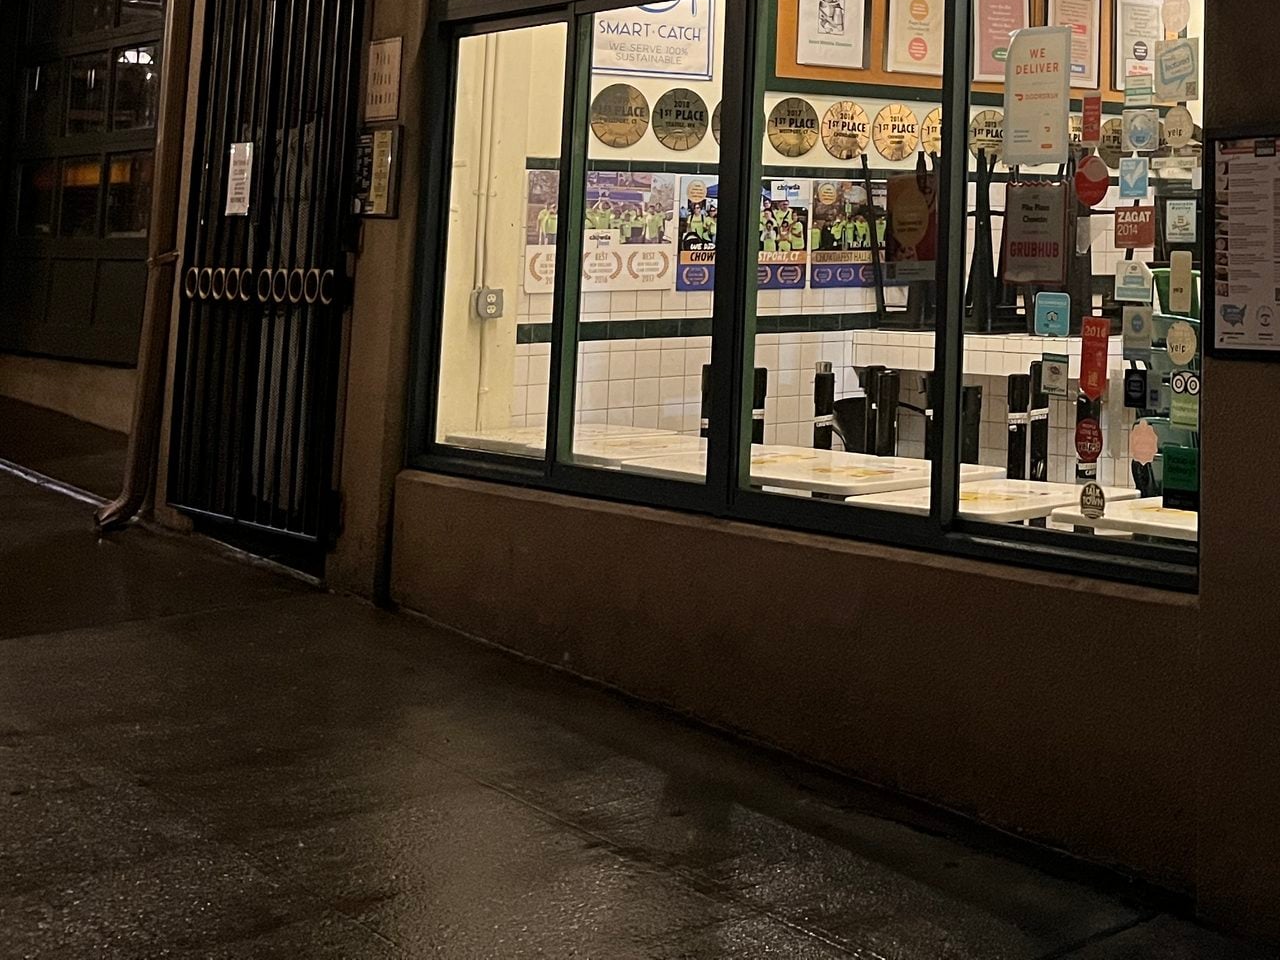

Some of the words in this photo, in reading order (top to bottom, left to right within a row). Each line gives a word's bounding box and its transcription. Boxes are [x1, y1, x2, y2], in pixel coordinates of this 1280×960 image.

[599, 20, 651, 37] SMART
[658, 25, 701, 41] CATCH
[609, 42, 628, 51] WE
[630, 44, 662, 54] SERVE
[666, 46, 688, 56] 100%
[1029, 48, 1046, 58] WE
[616, 53, 682, 65] SUSTAINABLE
[1016, 62, 1059, 74] DELIVER
[659, 109, 672, 119] 1ST
[675, 110, 704, 121] PLACE
[774, 118, 786, 127] 1ST
[789, 118, 815, 129] PLACE
[828, 120, 840, 130] 1ST
[841, 121, 866, 133] PLACE
[878, 124, 889, 133] 1ST
[891, 124, 915, 134] PLACE
[974, 128, 984, 137] 1ST
[986, 129, 1003, 138] PLAC
[1168, 128, 1183, 137] yelp
[1117, 211, 1151, 222] ZAGAT
[1117, 224, 1138, 235] 2014
[1010, 241, 1059, 257] GRUBHUB
[690, 251, 715, 262] CHOW
[758, 250, 789, 262] STPORT,
[1082, 496, 1104, 506] TOWN
